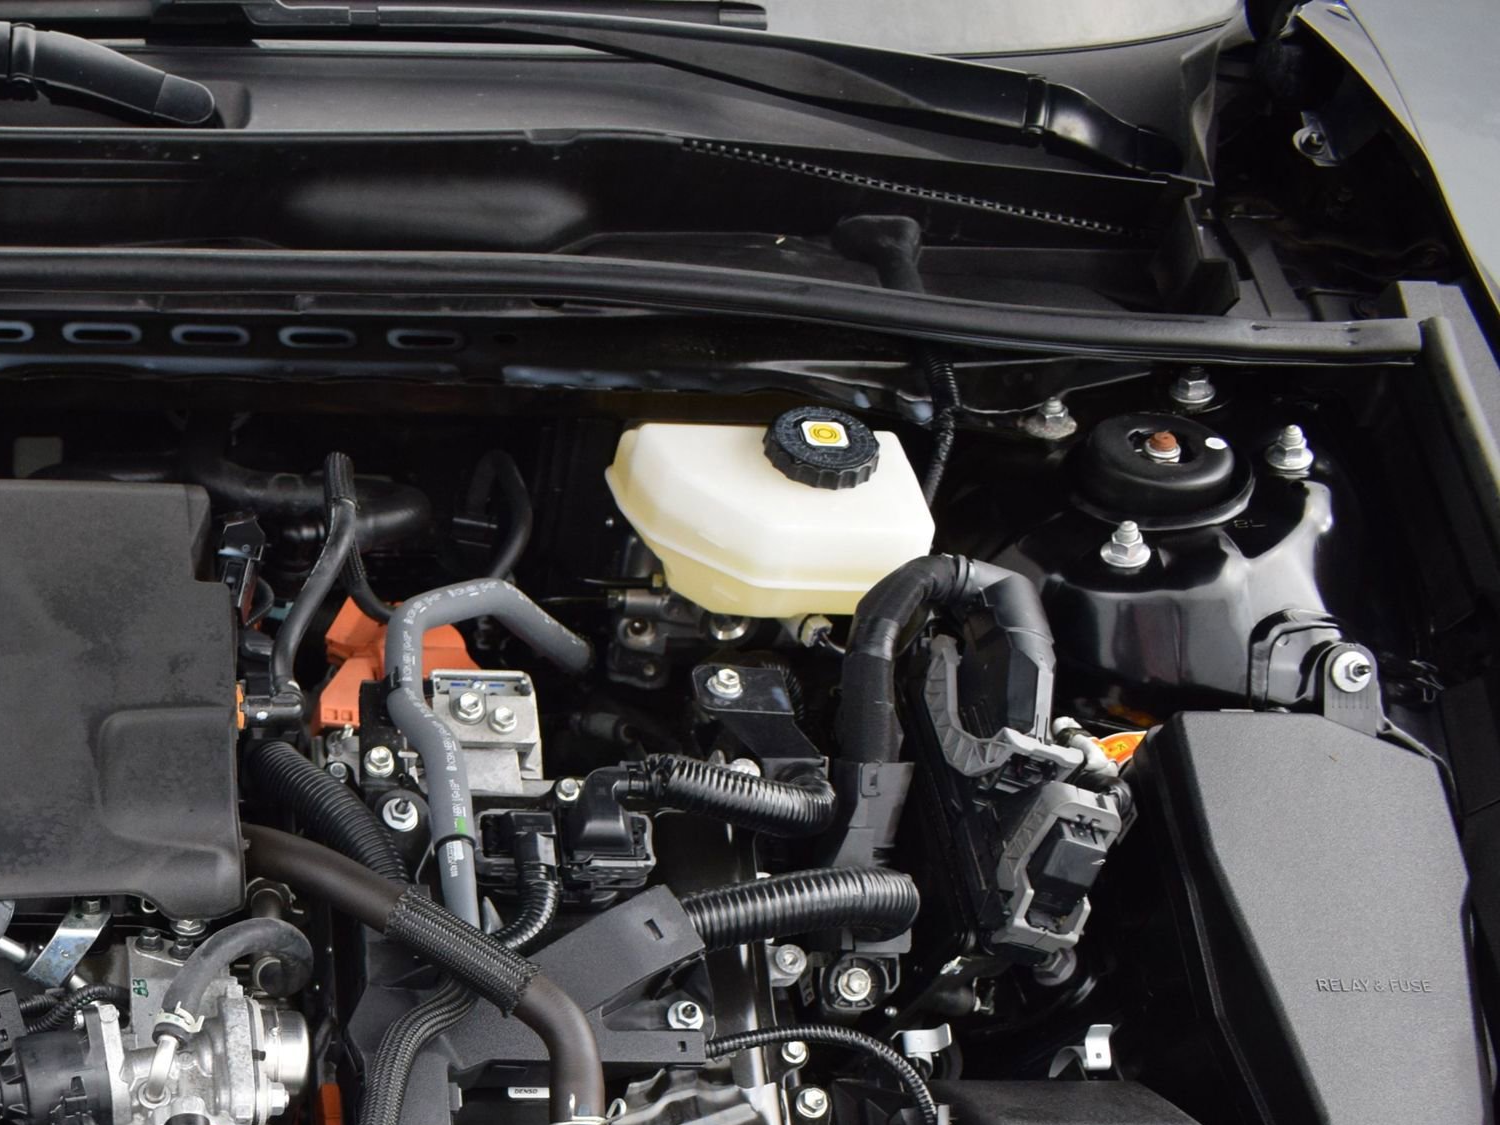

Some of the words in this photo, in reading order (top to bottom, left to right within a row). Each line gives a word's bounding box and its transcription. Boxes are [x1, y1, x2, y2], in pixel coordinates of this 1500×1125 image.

[1316, 978, 1370, 992] RELAY
[1373, 980, 1385, 992] &
[1389, 979, 1432, 993] FUSE
